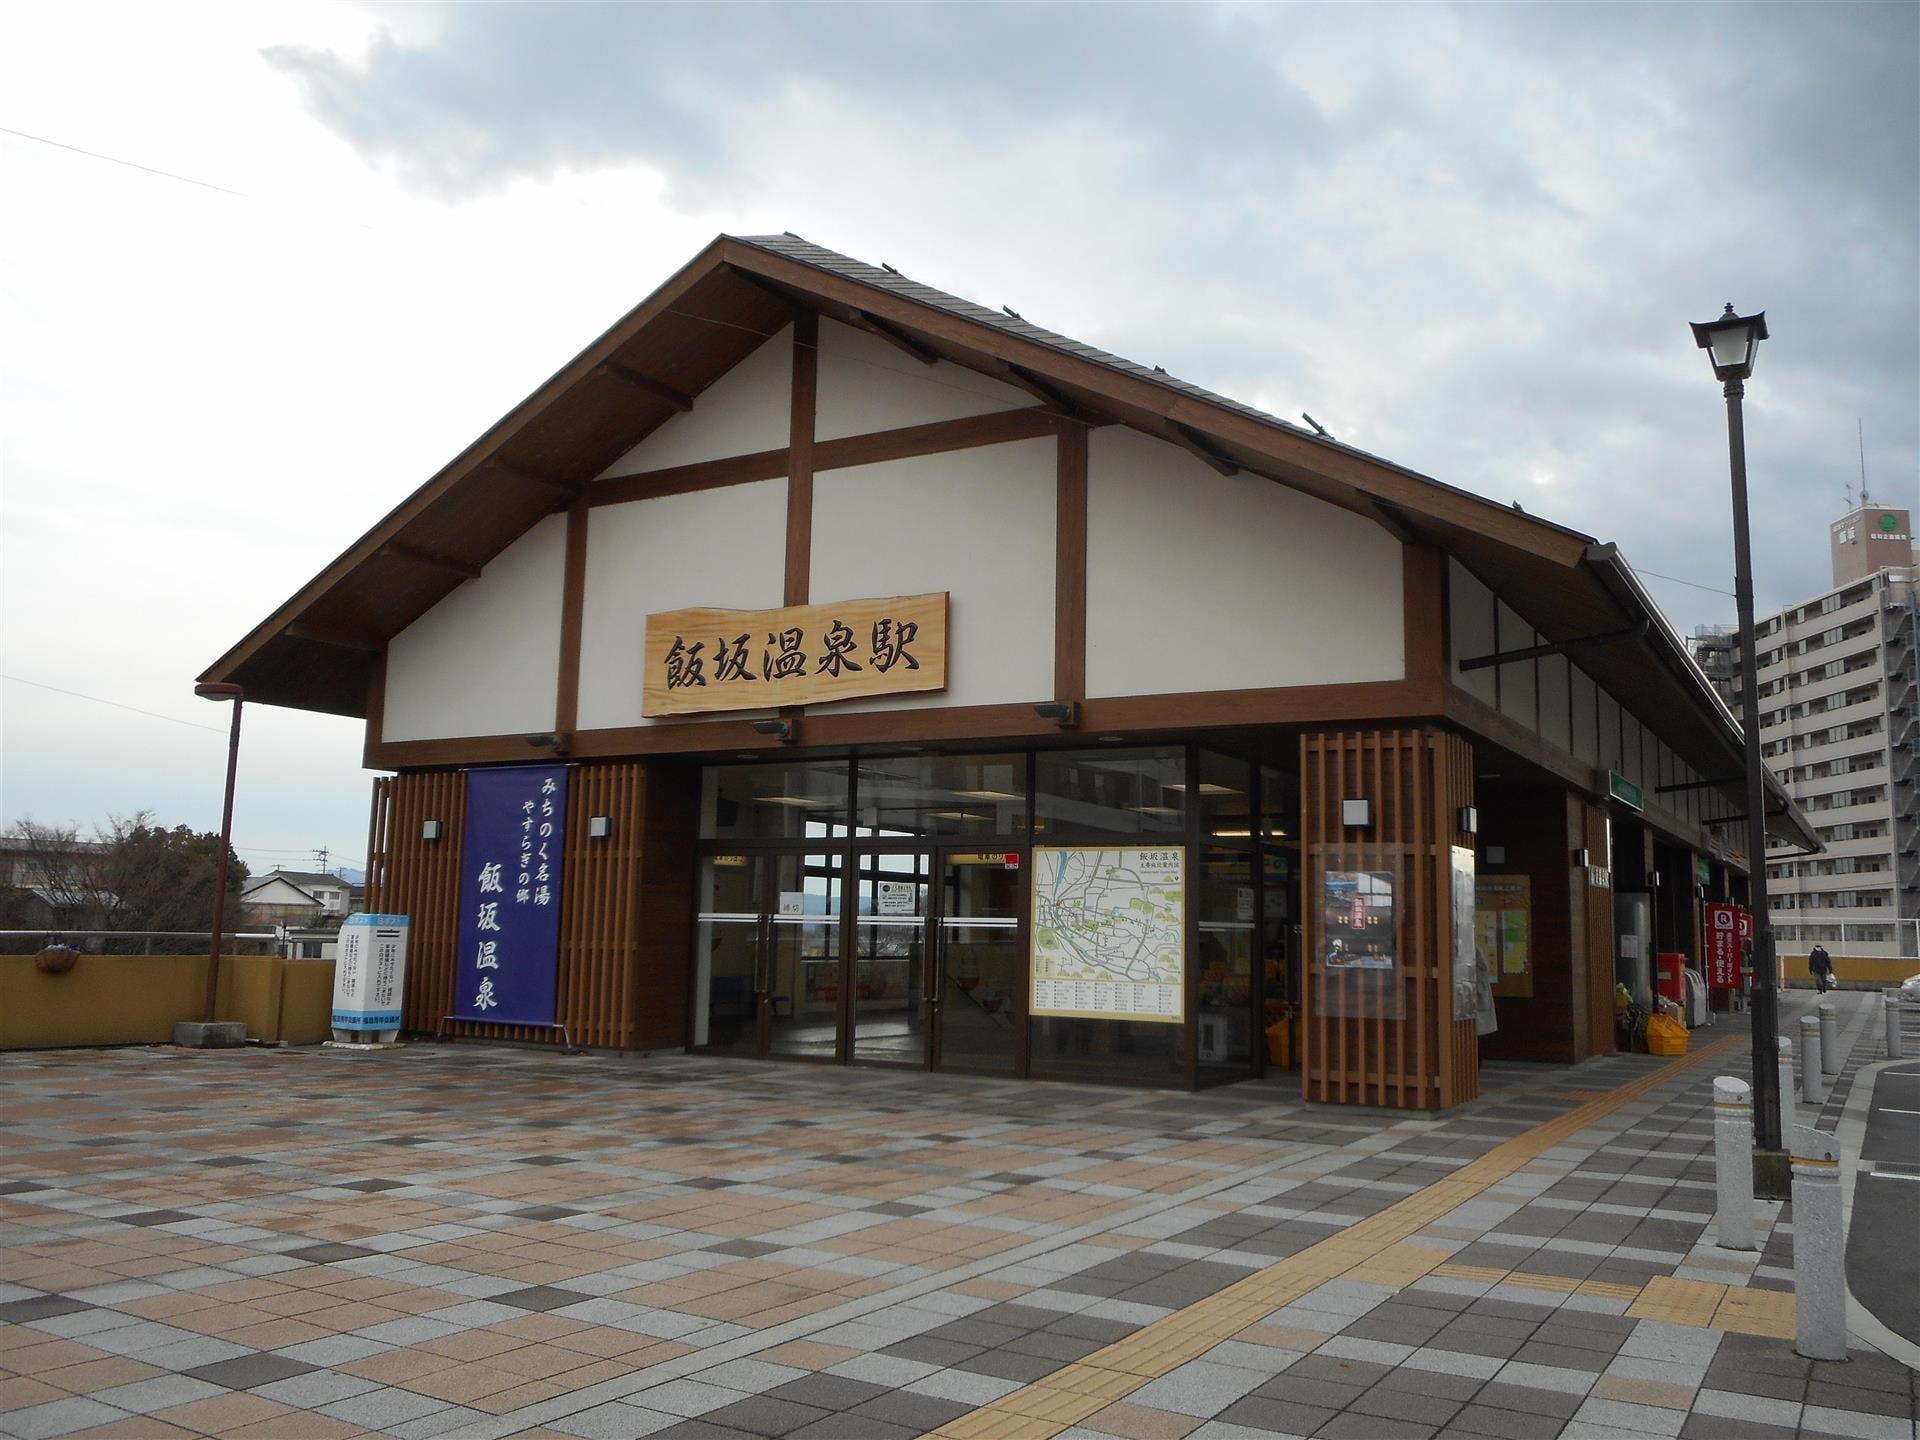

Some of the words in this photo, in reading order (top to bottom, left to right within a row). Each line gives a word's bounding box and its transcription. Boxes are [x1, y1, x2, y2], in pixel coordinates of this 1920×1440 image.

[664, 618, 919, 690] 飯坂温泉駅
[516, 799, 535, 905] やすらぎの郷
[534, 777, 557, 906] みちのく名湯
[1140, 851, 1180, 861] 飯坂温泉
[473, 861, 504, 1011] 飯坂温泉
